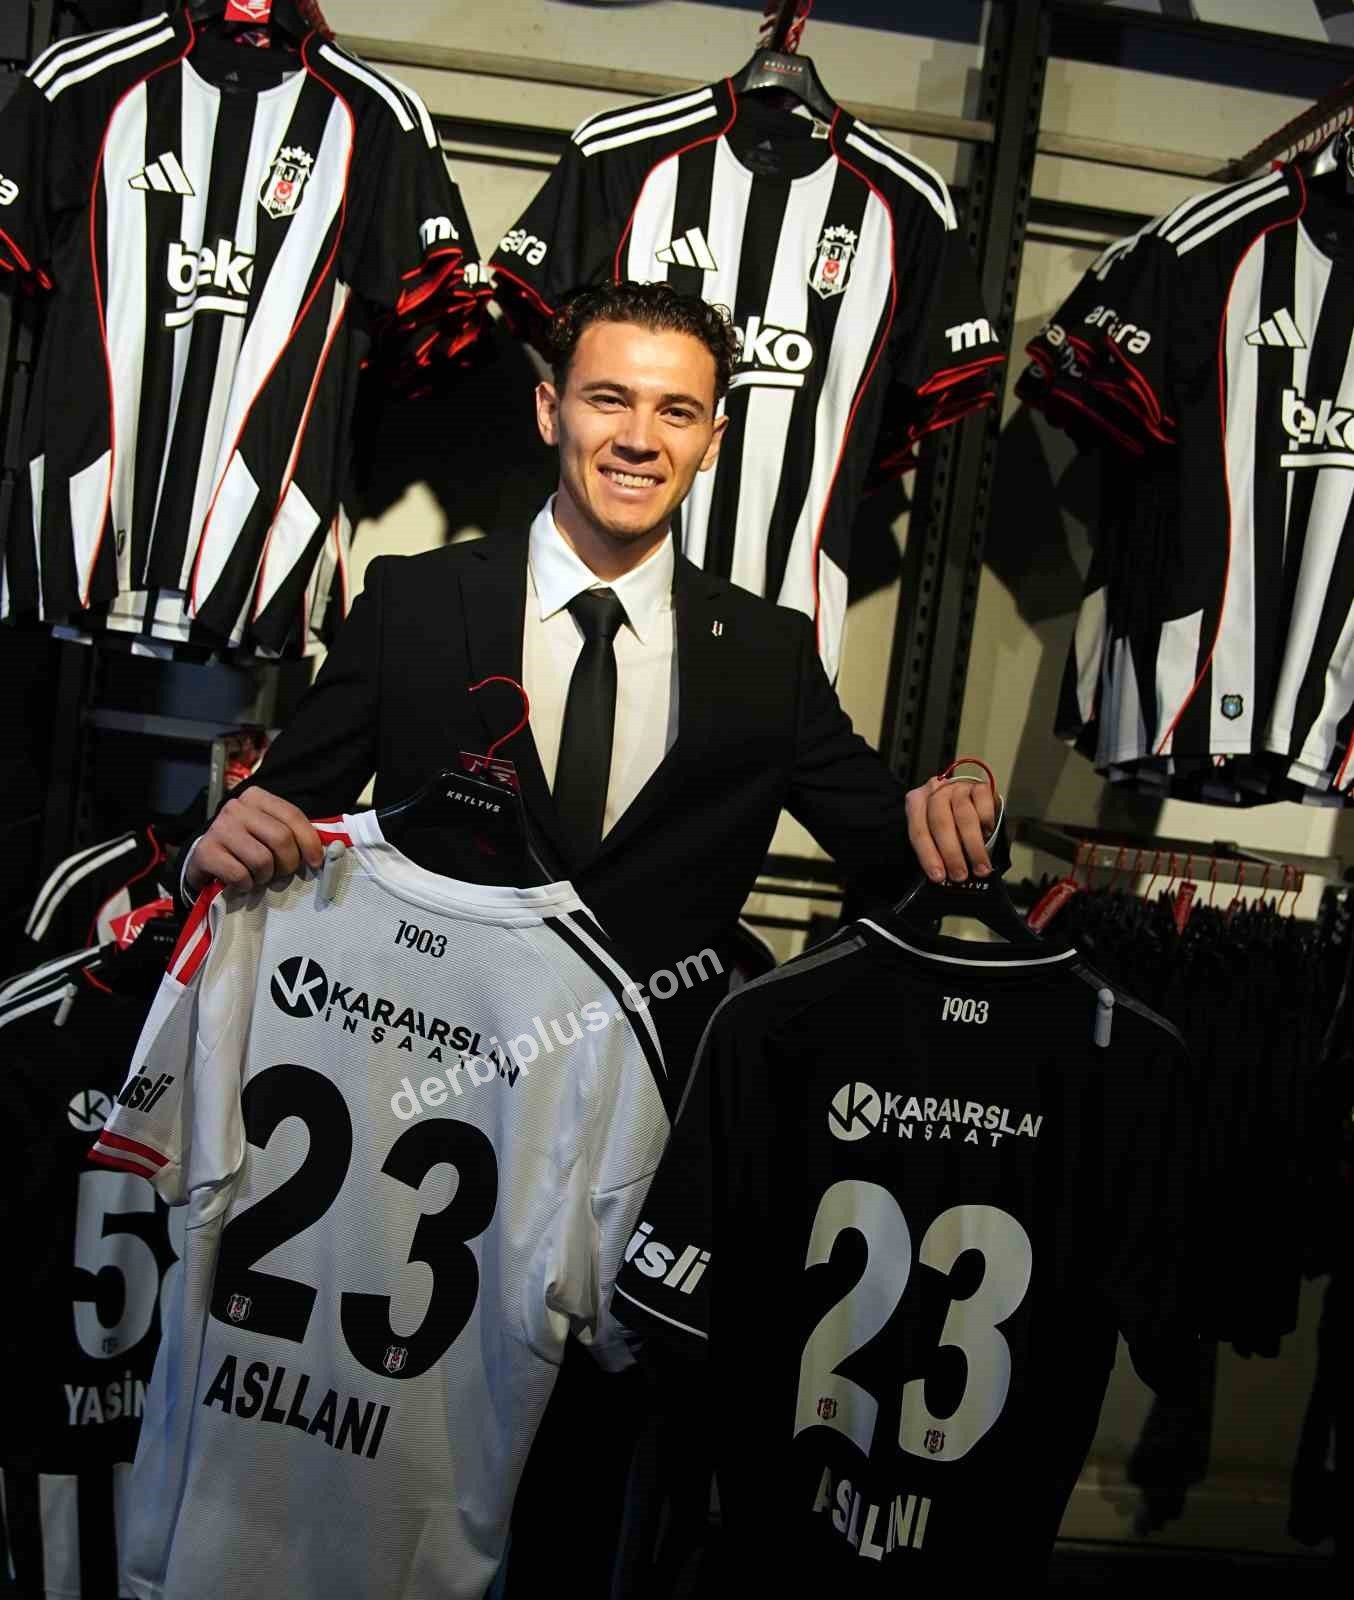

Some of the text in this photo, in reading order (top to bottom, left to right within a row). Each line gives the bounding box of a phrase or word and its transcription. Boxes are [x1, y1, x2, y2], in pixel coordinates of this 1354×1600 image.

[166, 238, 255, 296] bek
[1281, 389, 1354, 451] bek
[394, 919, 448, 959] 1903
[941, 996, 990, 1025] 1903
[210, 1063, 499, 1380] 23
[793, 1179, 1033, 1462] 23
[202, 1354, 391, 1460] ASLLANI
